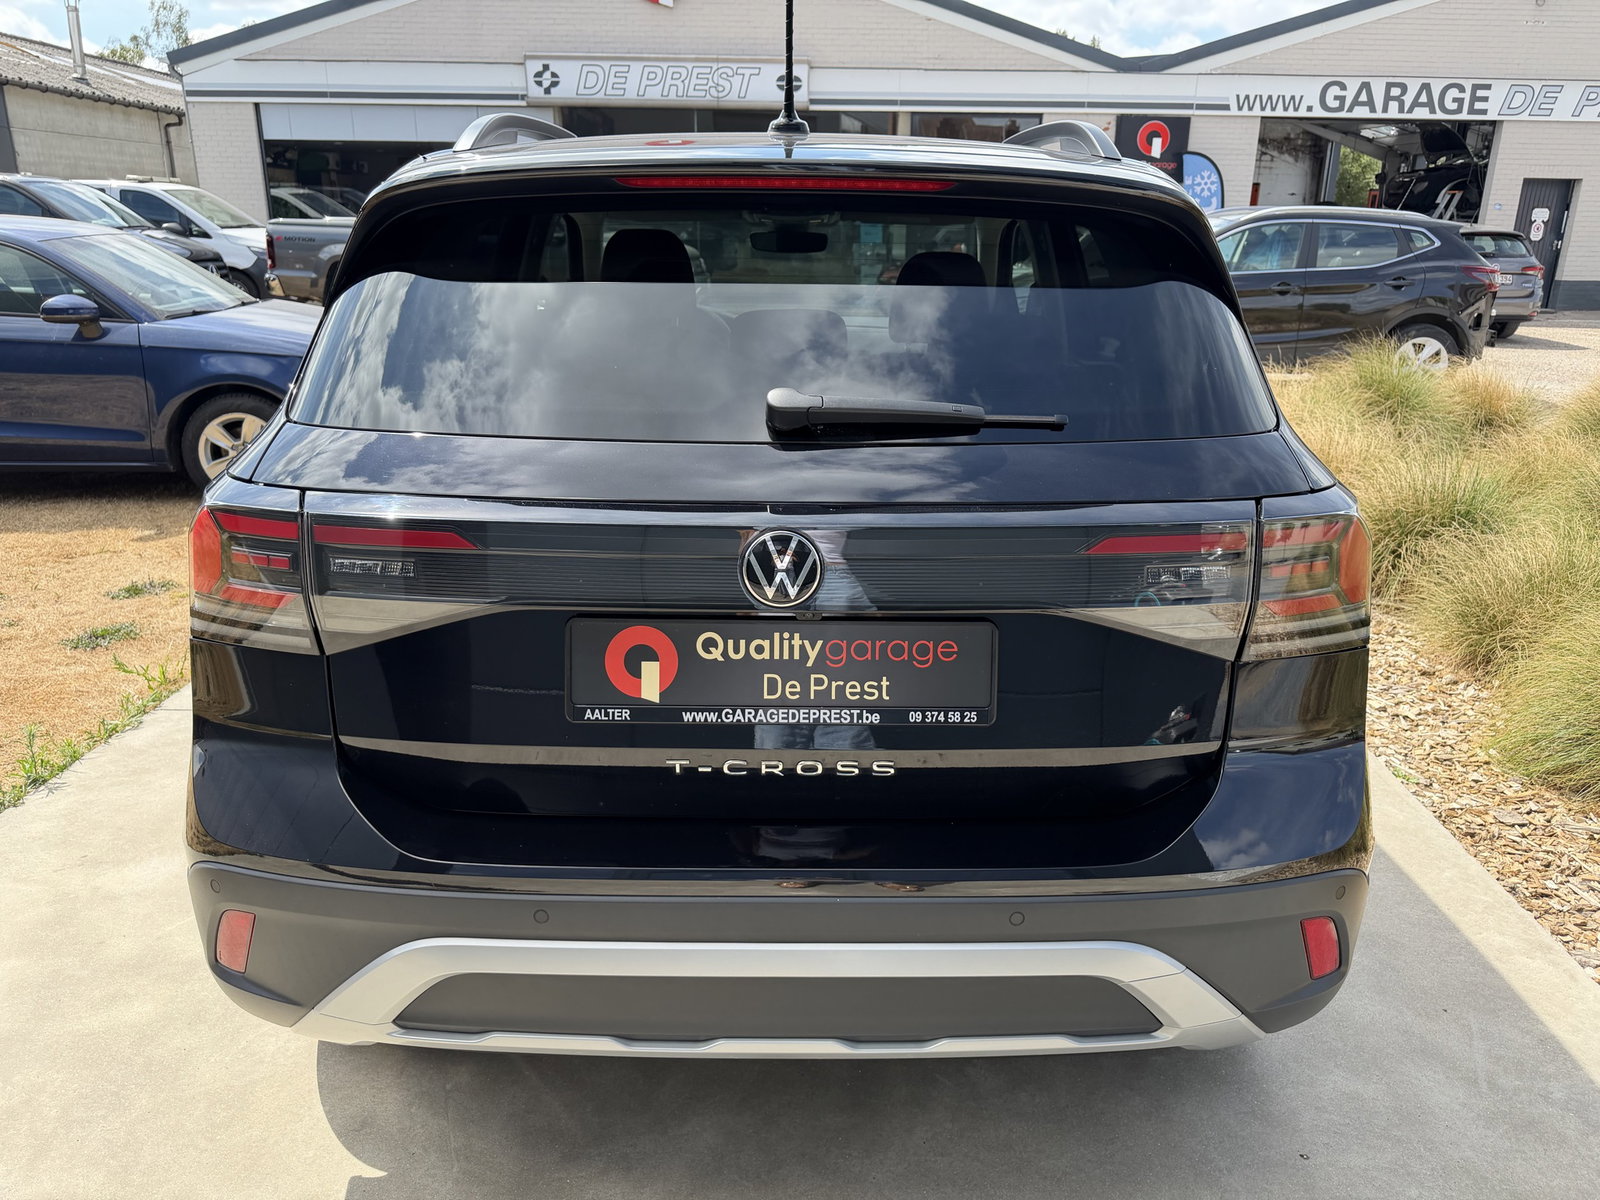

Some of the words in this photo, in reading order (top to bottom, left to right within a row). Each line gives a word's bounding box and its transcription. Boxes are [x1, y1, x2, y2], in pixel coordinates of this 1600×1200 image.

[576, 64, 631, 97] DE
[637, 65, 761, 99] PREST
[1235, 79, 1493, 117] www.GARAGE
[1497, 84, 1564, 118] DE
[1571, 85, 1600, 118] P
[695, 631, 959, 668] Qualitygarage
[763, 673, 801, 700] De
[809, 674, 890, 701] Prest
[584, 708, 631, 721] AALTER
[681, 708, 881, 725] www.GARAGEDEPREST.be
[908, 710, 923, 723] 09
[925, 710, 945, 723] 374
[947, 710, 961, 723] 58
[963, 710, 978, 723] 25
[665, 758, 896, 778] T-CROSS
